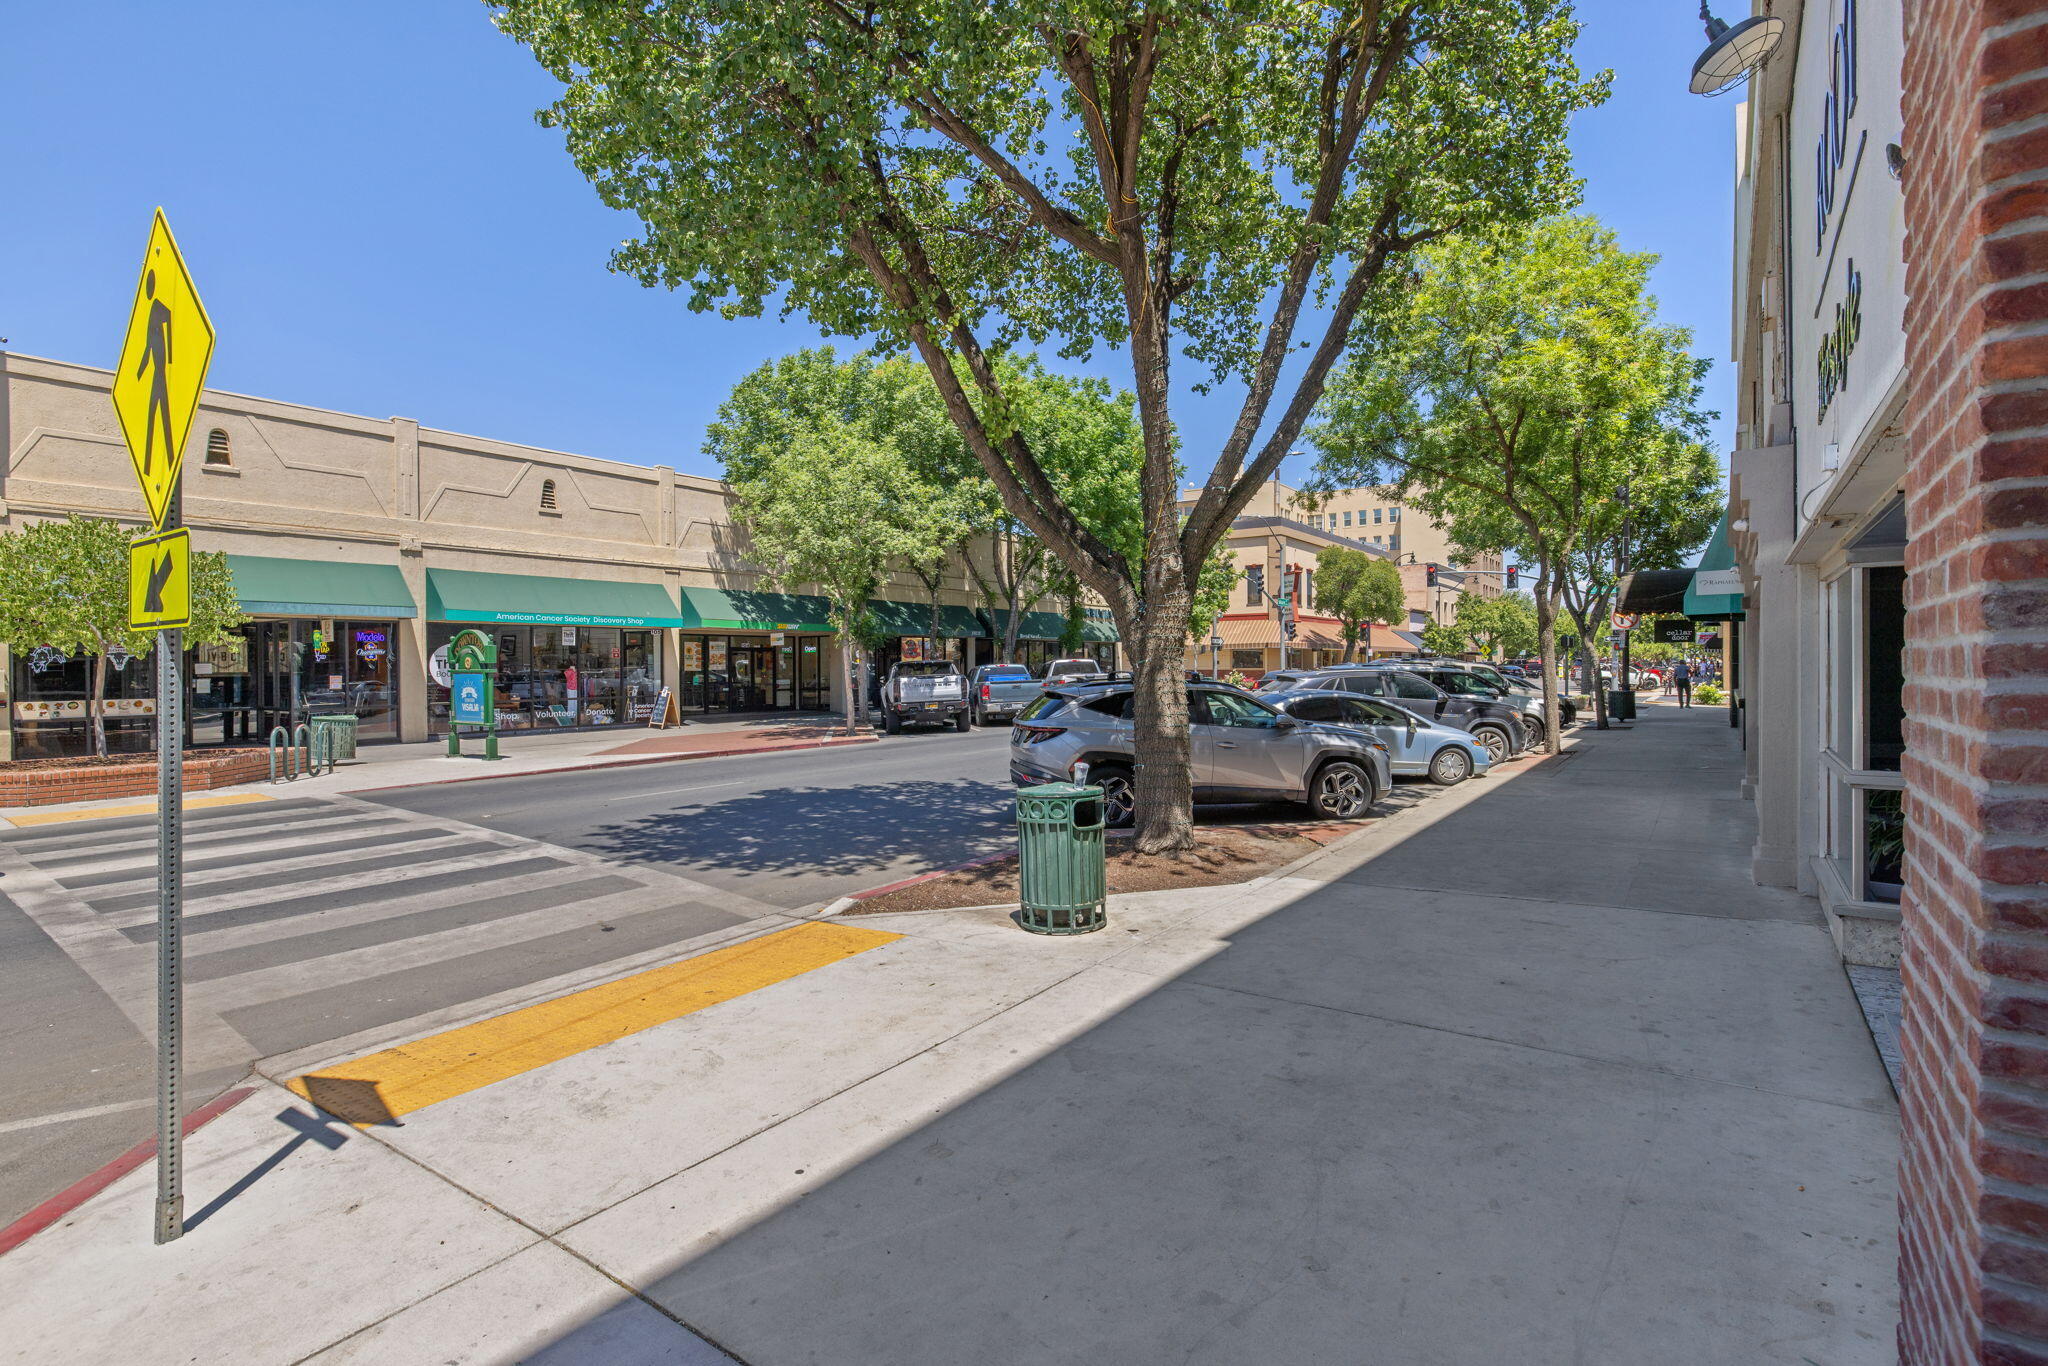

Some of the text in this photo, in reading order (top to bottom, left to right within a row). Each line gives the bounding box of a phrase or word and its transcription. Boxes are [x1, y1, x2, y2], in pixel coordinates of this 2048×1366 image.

[496, 613, 534, 621] American
[565, 616, 591, 624] Society
[593, 616, 627, 625] Discovery
[628, 617, 644, 625] Shop
[356, 631, 385, 642] Modelo
[1671, 633, 1690, 641] door
[494, 711, 520, 721] Shop.
[586, 708, 616, 716] Donate.
